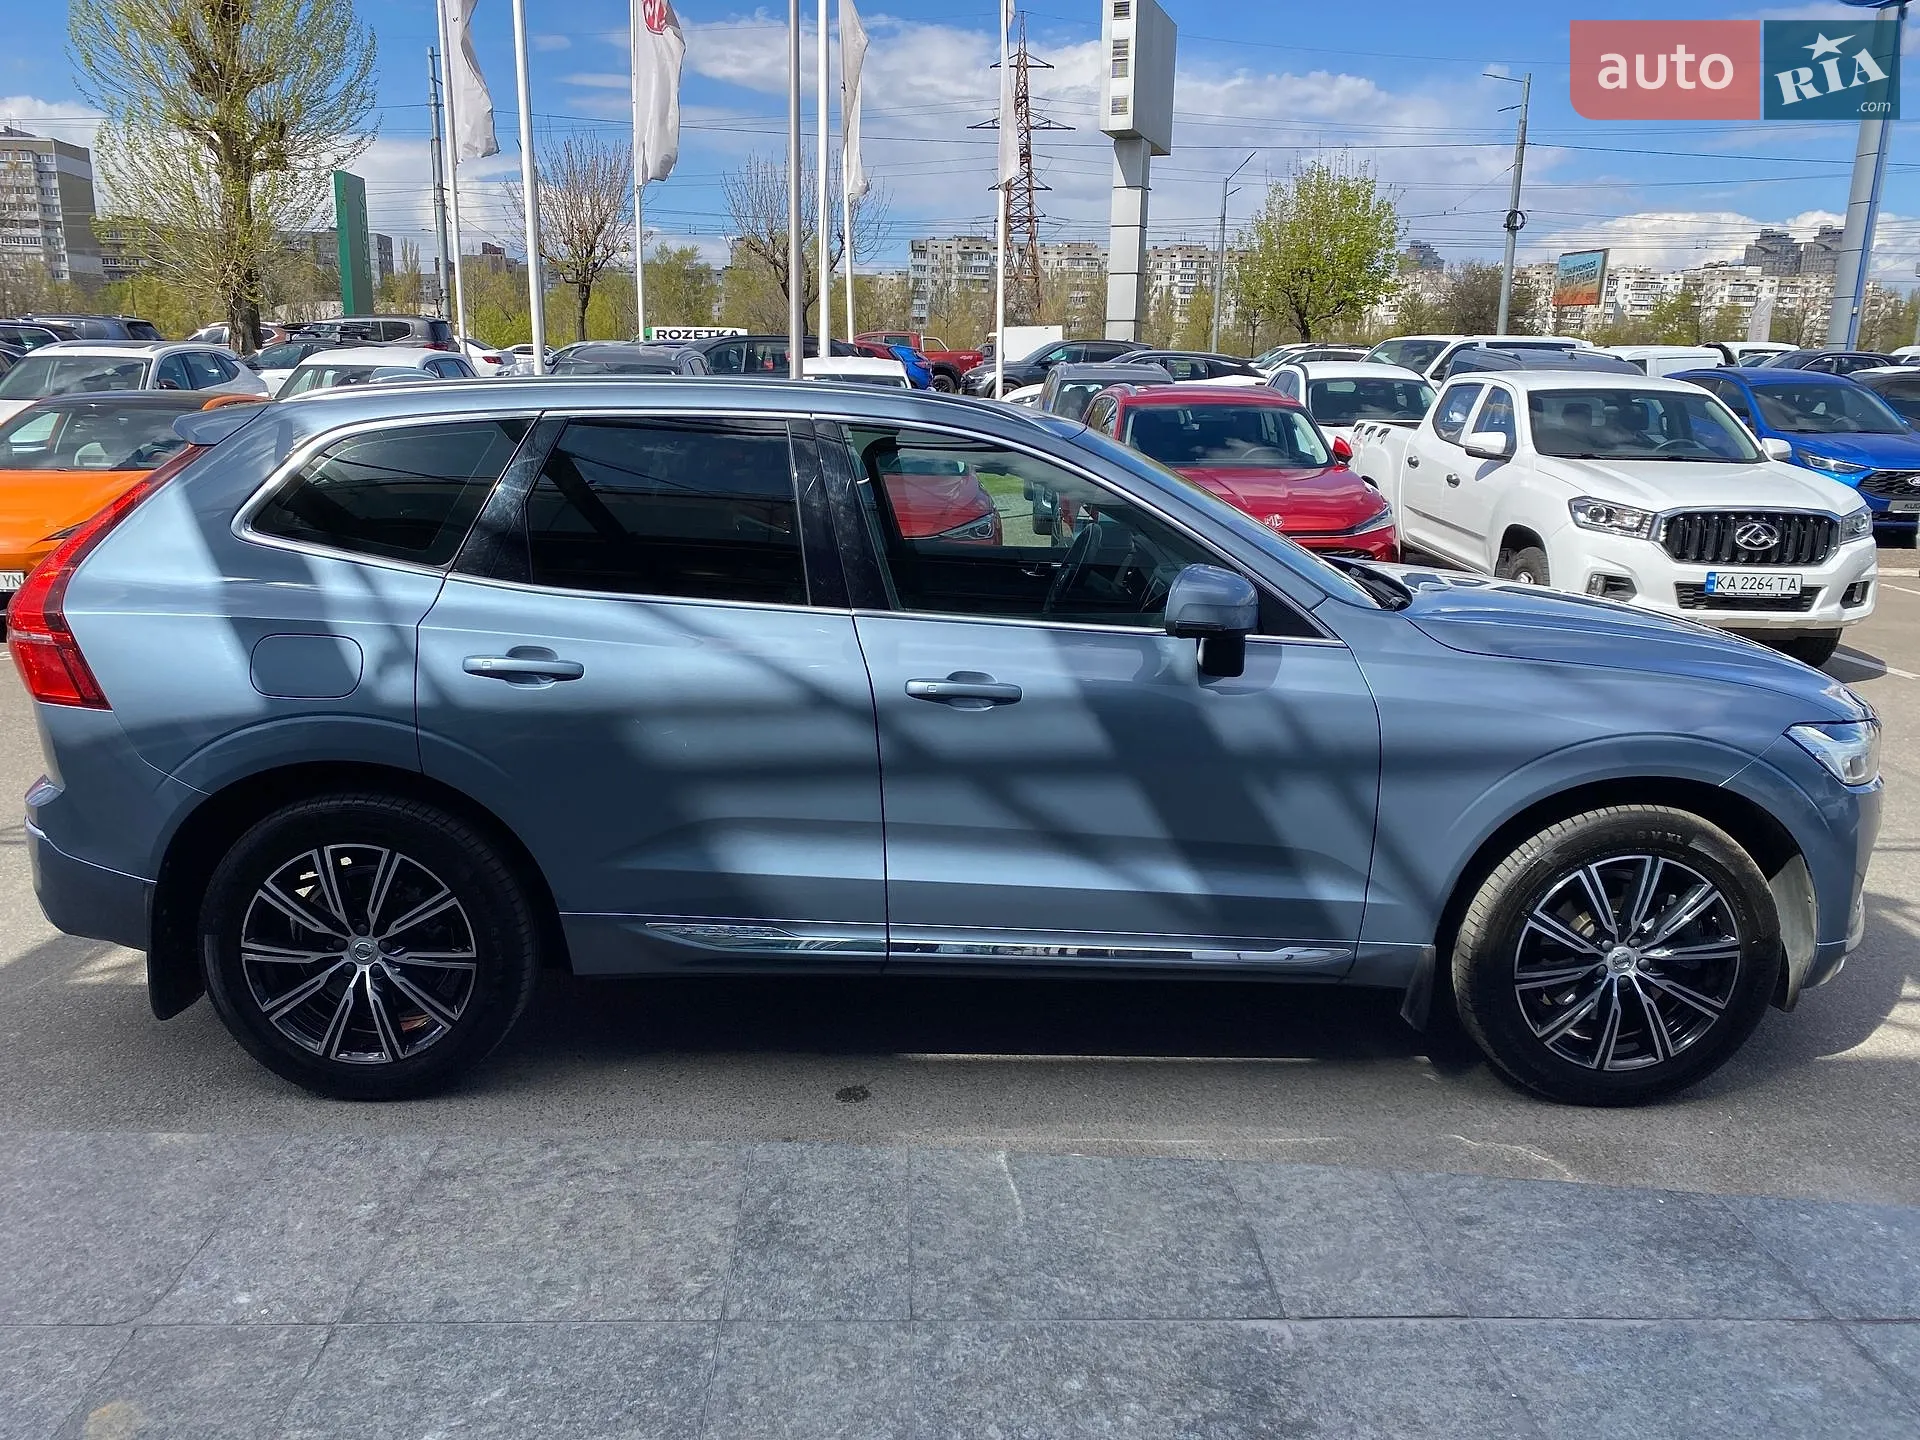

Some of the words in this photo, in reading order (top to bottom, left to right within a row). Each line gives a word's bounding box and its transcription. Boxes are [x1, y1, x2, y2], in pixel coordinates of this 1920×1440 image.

[656, 329, 739, 340] ROZETKA
[1716, 576, 1736, 589] KA
[1741, 577, 1773, 590] 2264
[1778, 577, 1797, 590] TA
